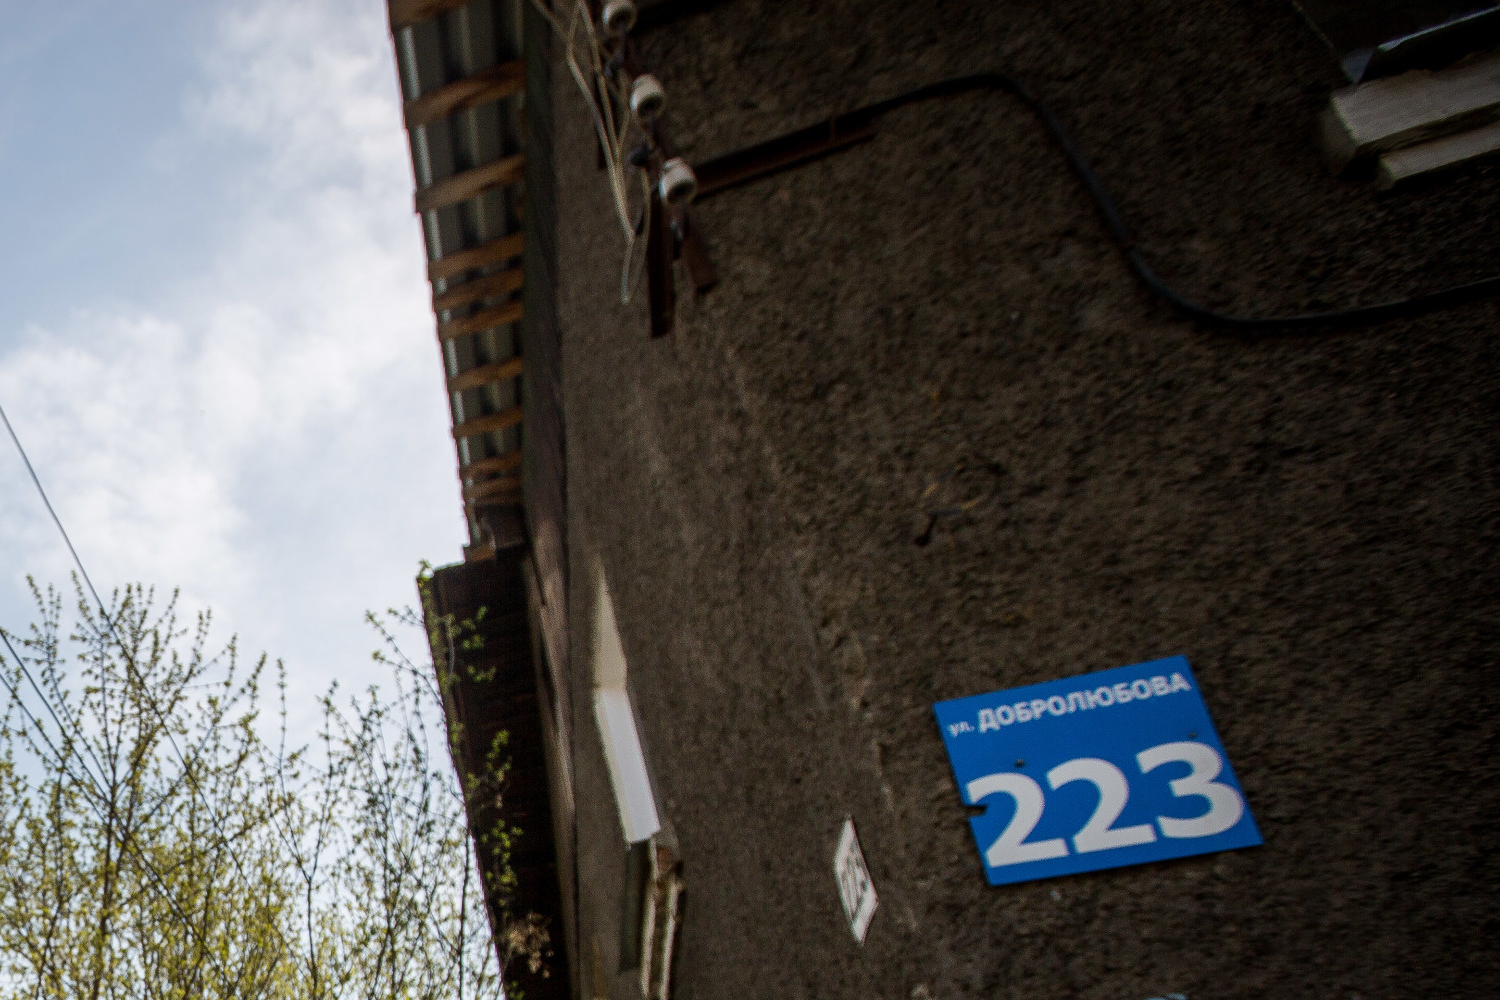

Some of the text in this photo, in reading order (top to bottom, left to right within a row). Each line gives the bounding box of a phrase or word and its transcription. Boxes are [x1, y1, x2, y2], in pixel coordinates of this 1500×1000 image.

[948, 673, 1192, 737] ул. ДОБРОЛЮБОВА
[967, 741, 1245, 867] 223
